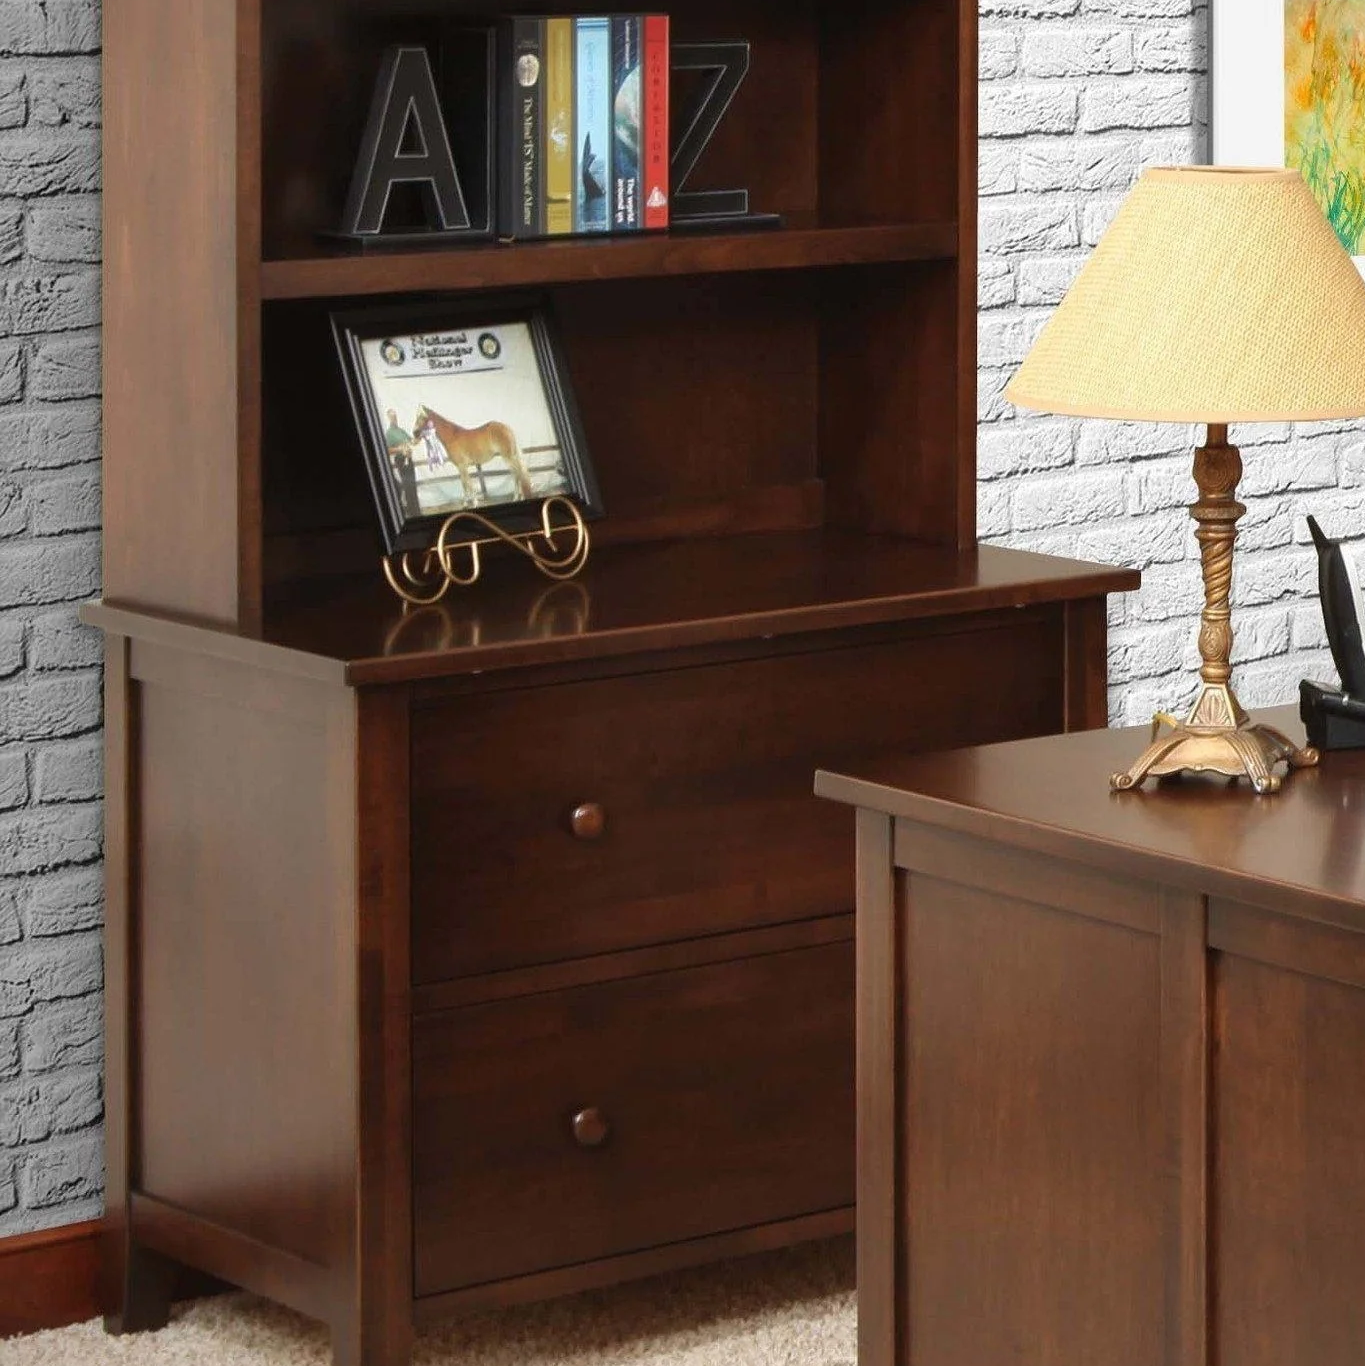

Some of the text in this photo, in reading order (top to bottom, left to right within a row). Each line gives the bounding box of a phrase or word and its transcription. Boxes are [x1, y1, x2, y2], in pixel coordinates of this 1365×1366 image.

[523, 98, 533, 115] The
[523, 116, 533, 139] Mind
[627, 178, 635, 194] The
[615, 178, 625, 223] around us
[410, 332, 467, 346] National
